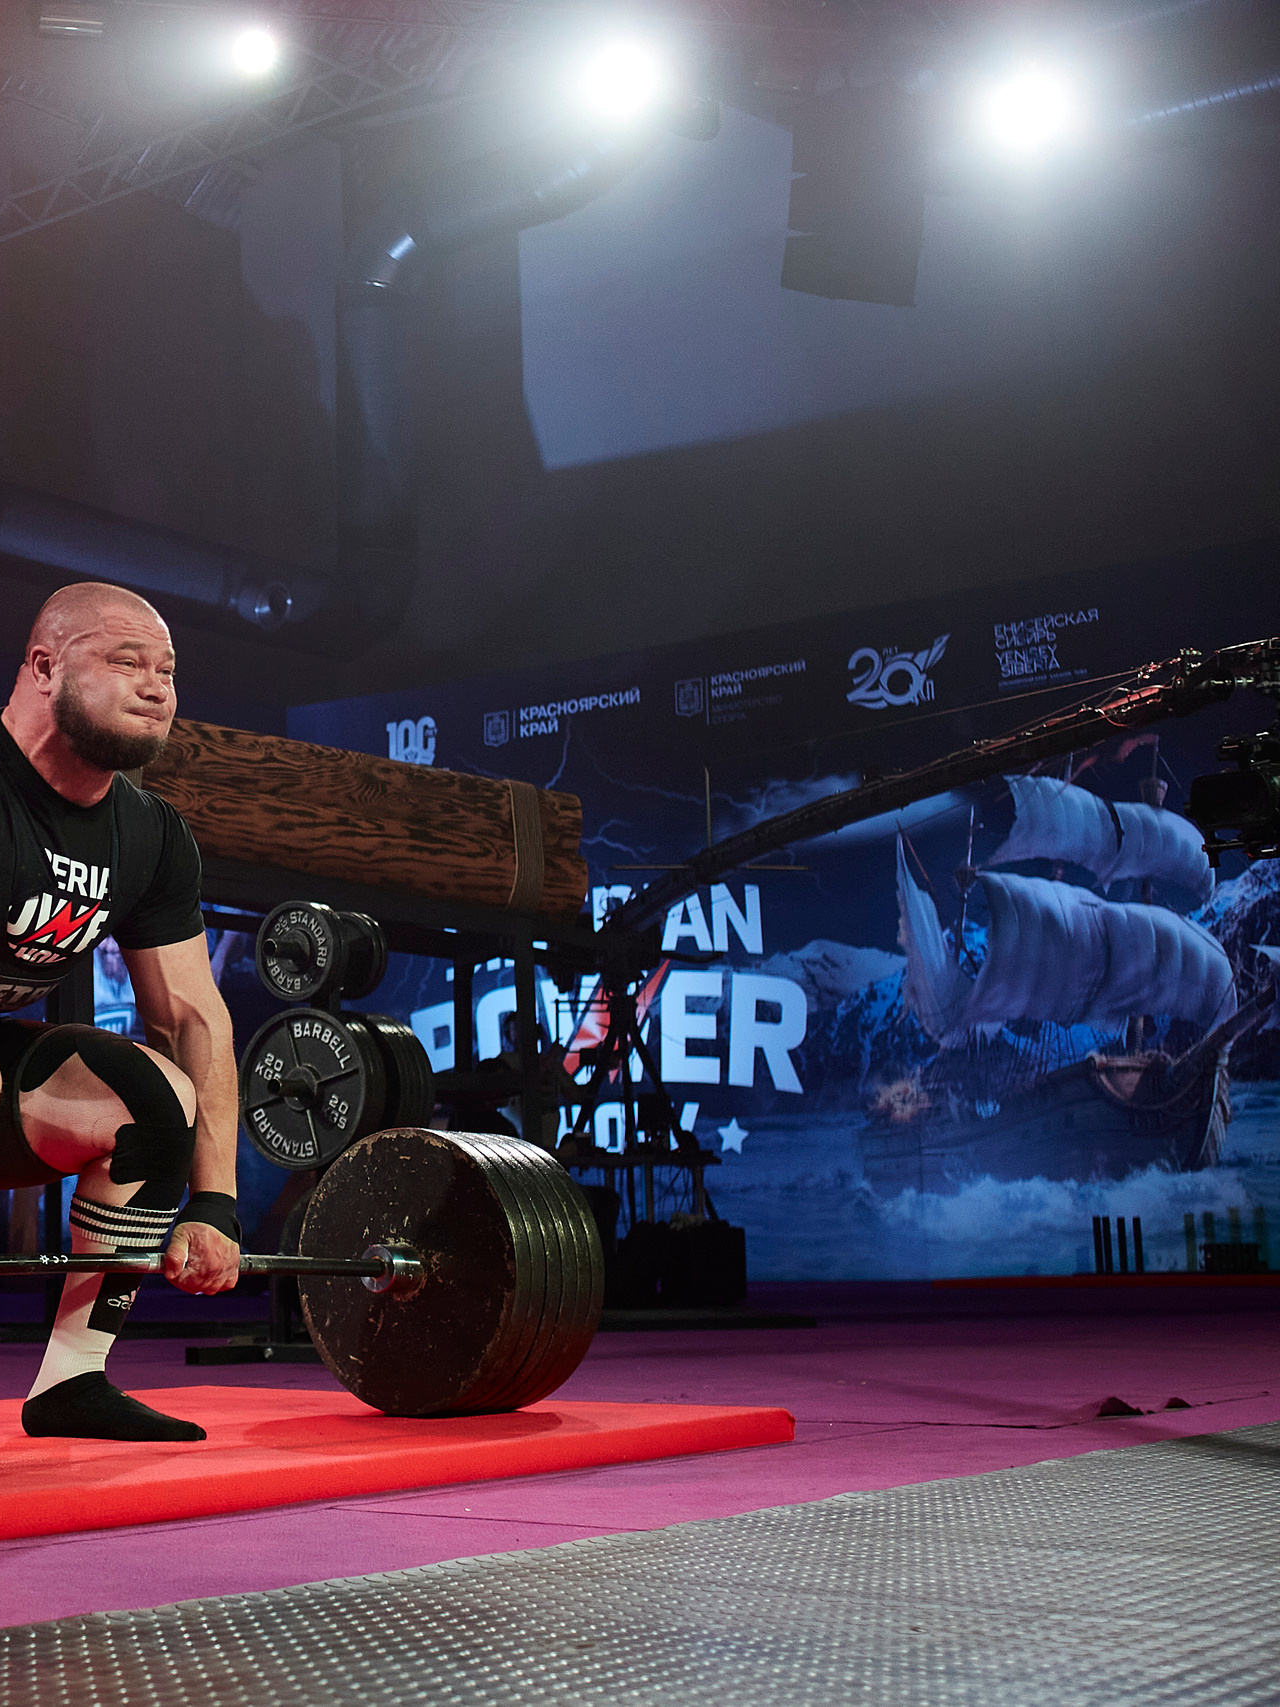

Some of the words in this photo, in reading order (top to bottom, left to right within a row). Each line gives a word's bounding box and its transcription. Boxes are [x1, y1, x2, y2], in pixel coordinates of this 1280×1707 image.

[711, 659, 807, 685] КРАСНОЯРСКИЙ
[520, 686, 641, 721] КРАСНОЯРСКИЙ
[711, 682, 743, 699] КРАЙ
[386, 716, 436, 764] 100
[520, 716, 559, 738] КРАЙ
[289, 910, 328, 968] STANDARD
[293, 1022, 353, 1070] BARBELL
[264, 1053, 284, 1072] 20
[327, 1093, 349, 1115] 20
[252, 1107, 315, 1159] STANDARD
